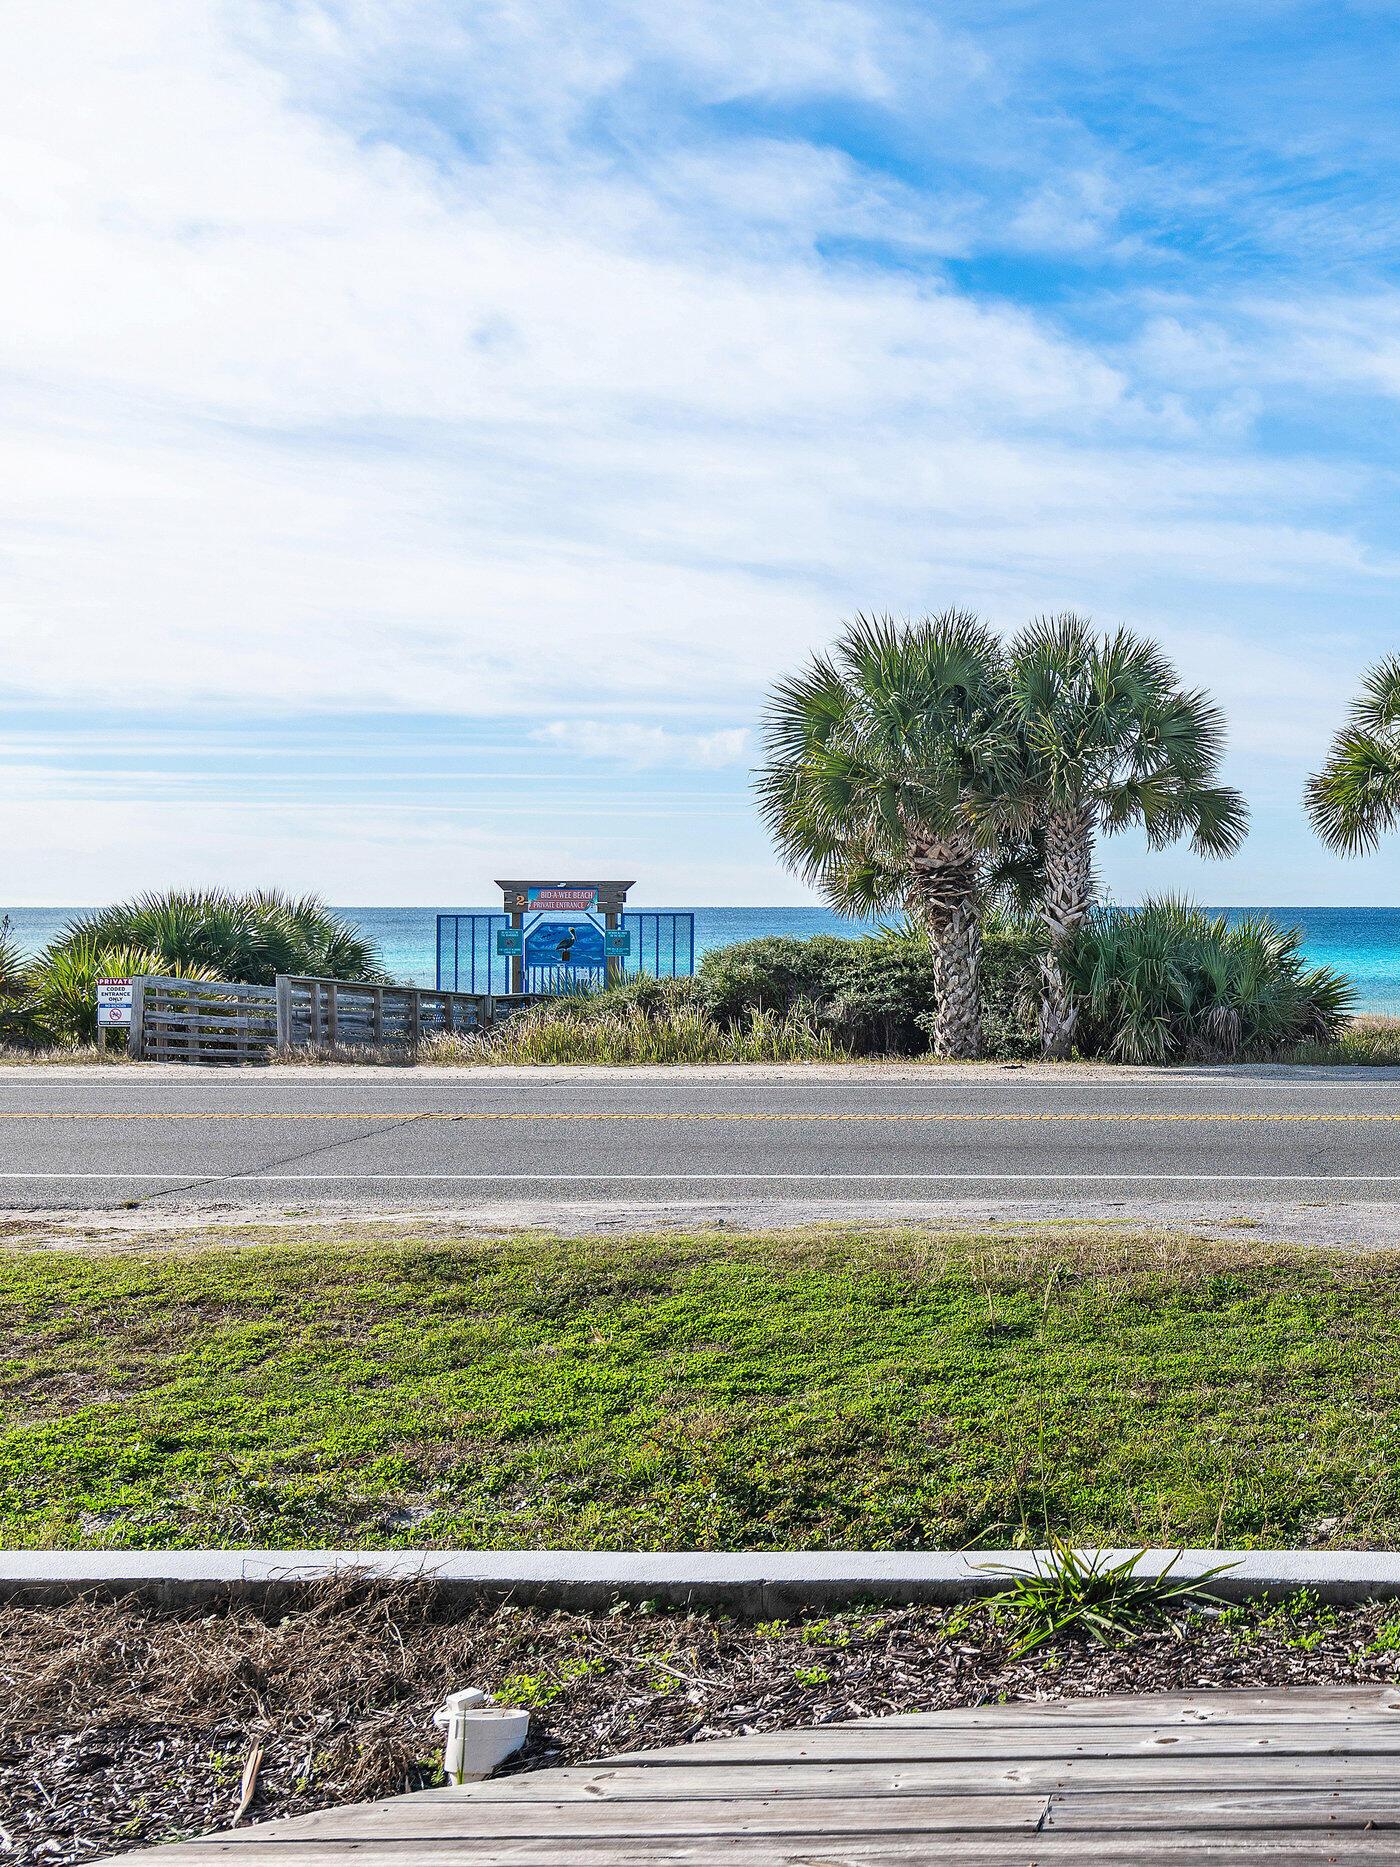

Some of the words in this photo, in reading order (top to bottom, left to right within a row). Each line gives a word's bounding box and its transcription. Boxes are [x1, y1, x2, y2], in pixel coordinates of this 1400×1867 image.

[540, 891, 572, 899] BID-A-WEE
[573, 891, 593, 899] BEACH
[516, 895, 525, 906] 2
[533, 901, 555, 909] PRIVATE
[556, 901, 584, 909] ENTRANCE
